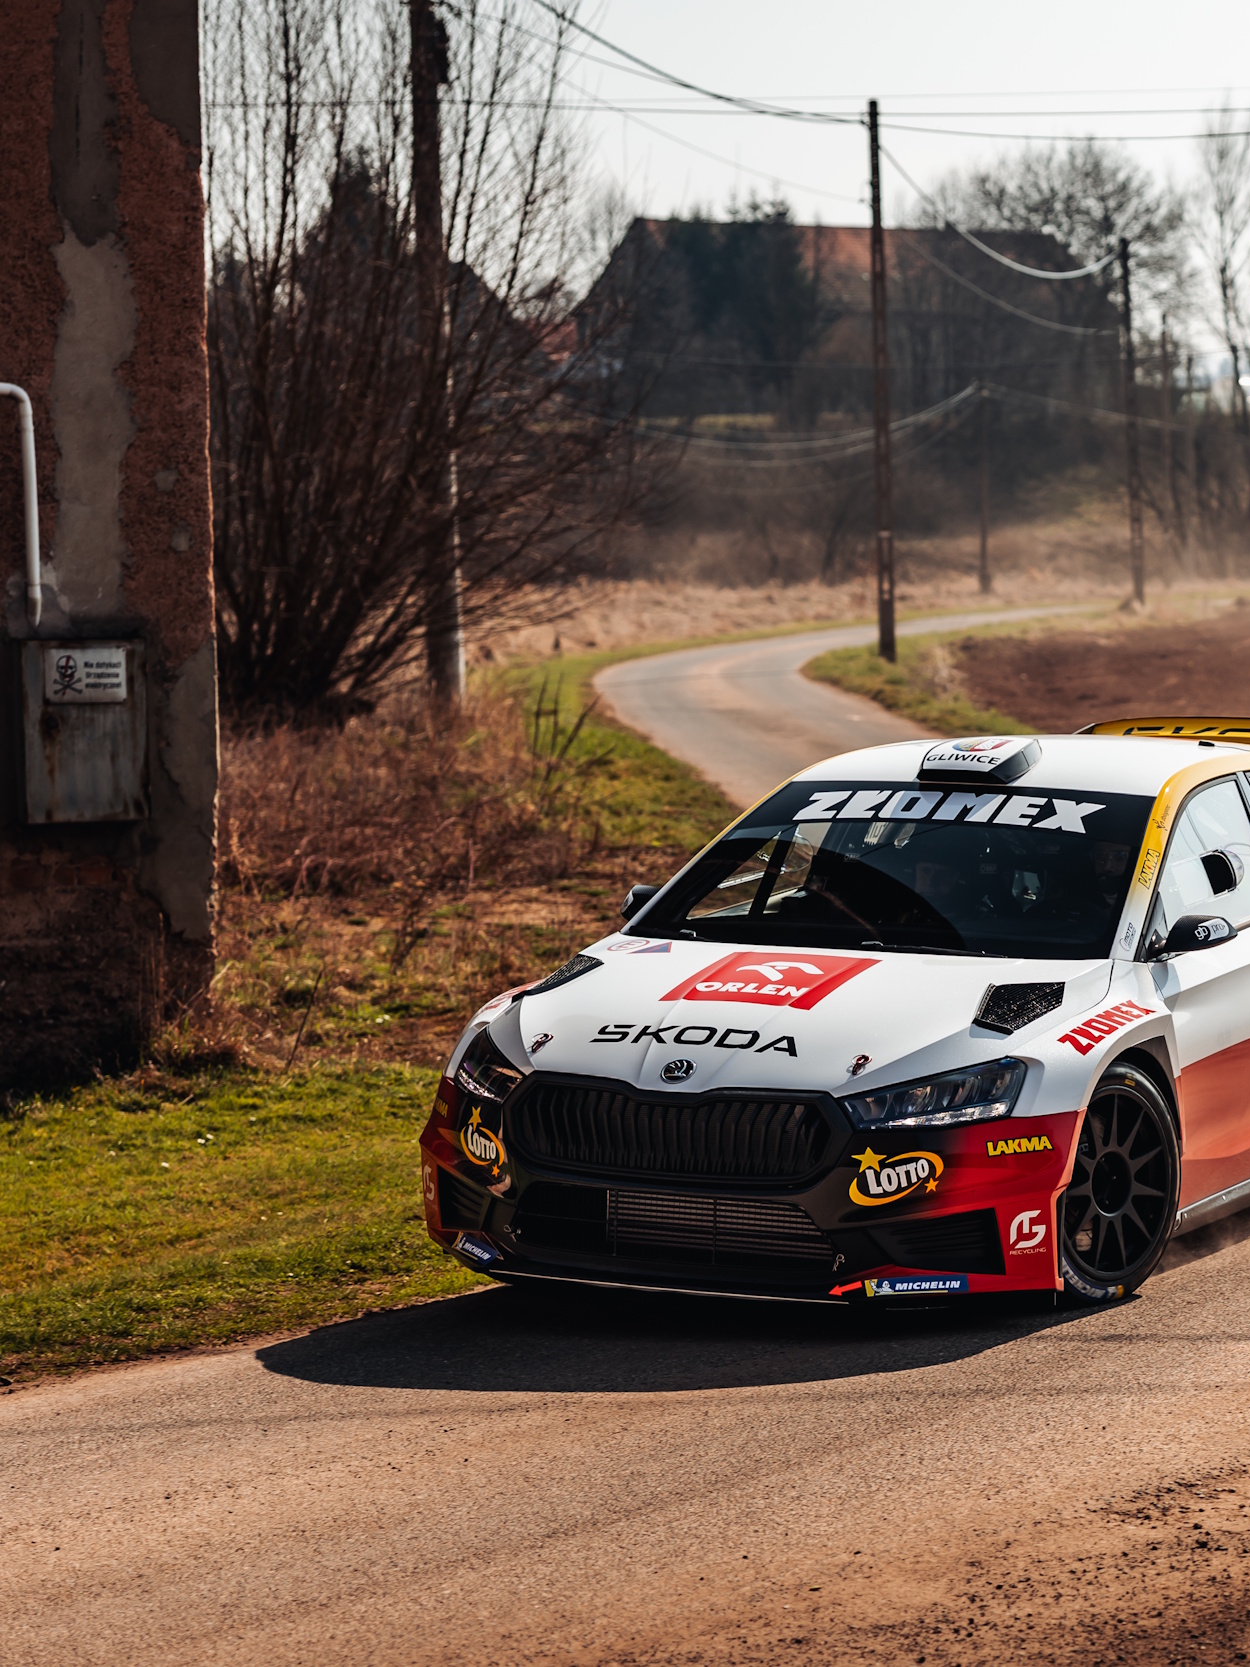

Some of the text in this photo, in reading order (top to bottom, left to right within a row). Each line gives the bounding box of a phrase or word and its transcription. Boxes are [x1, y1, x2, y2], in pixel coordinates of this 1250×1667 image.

[926, 753, 1001, 765] GLIWICE
[1194, 926, 1208, 940] gb
[695, 981, 809, 998] ORLEN
[467, 1125, 497, 1160] LOTTO
[986, 1135, 1053, 1157] LAKMA
[865, 1158, 930, 1195] LOTTO
[463, 1241, 492, 1261] MICHELIN
[1009, 1247, 1047, 1256] RECYCLING
[894, 1280, 961, 1292] MICHELIN
